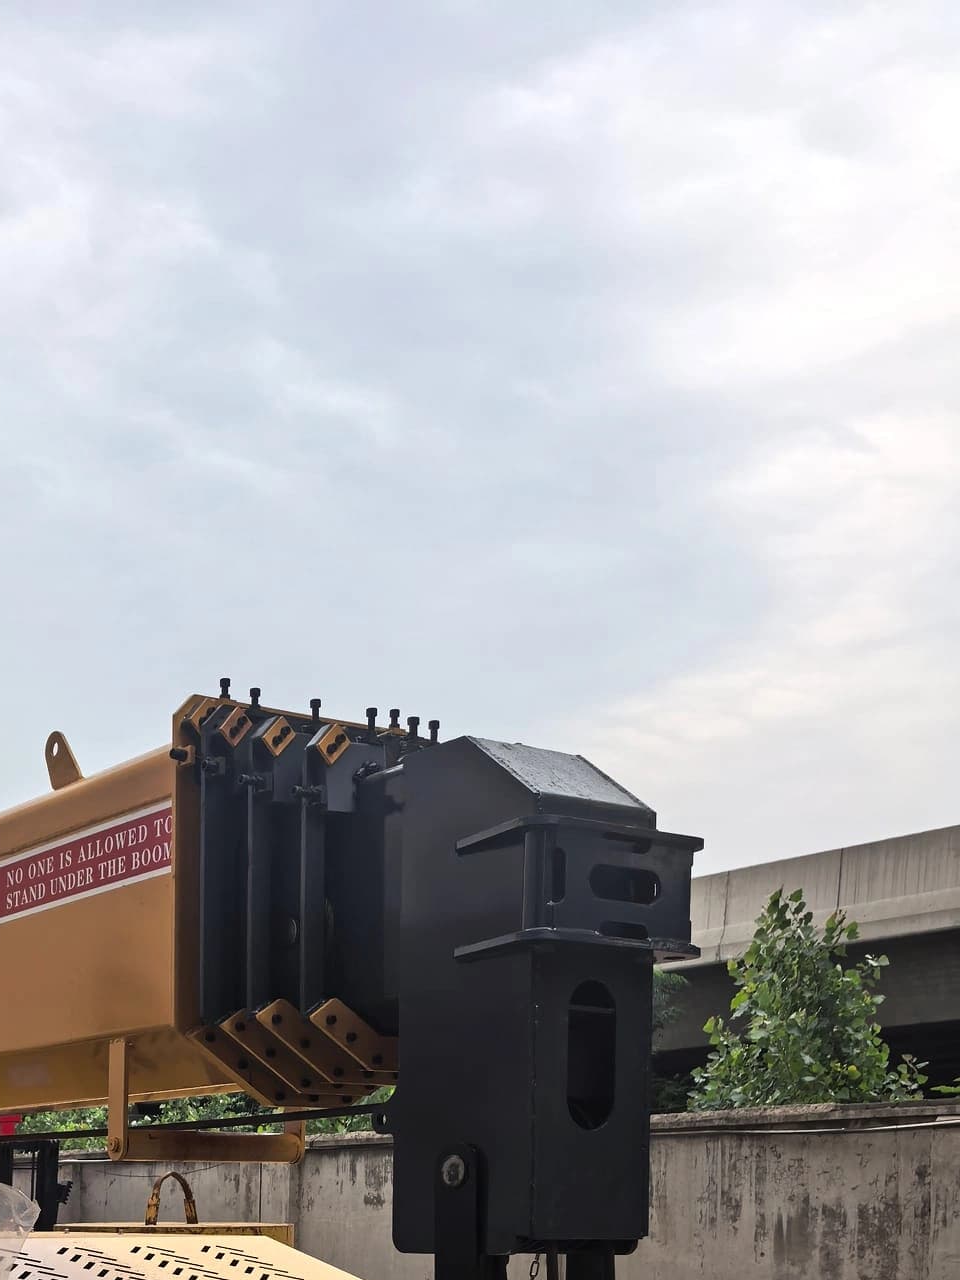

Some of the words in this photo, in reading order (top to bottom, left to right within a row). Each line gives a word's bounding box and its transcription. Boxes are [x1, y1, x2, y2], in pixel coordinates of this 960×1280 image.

[6, 868, 23, 887] NO
[28, 856, 54, 880] ONE
[59, 850, 72, 870] IS
[77, 824, 148, 864] ALLOWED
[154, 815, 173, 838] TO
[6, 882, 46, 910] STAND
[50, 867, 94, 896] UNDER
[98, 856, 126, 880] THE
[131, 841, 173, 870] BOOM
